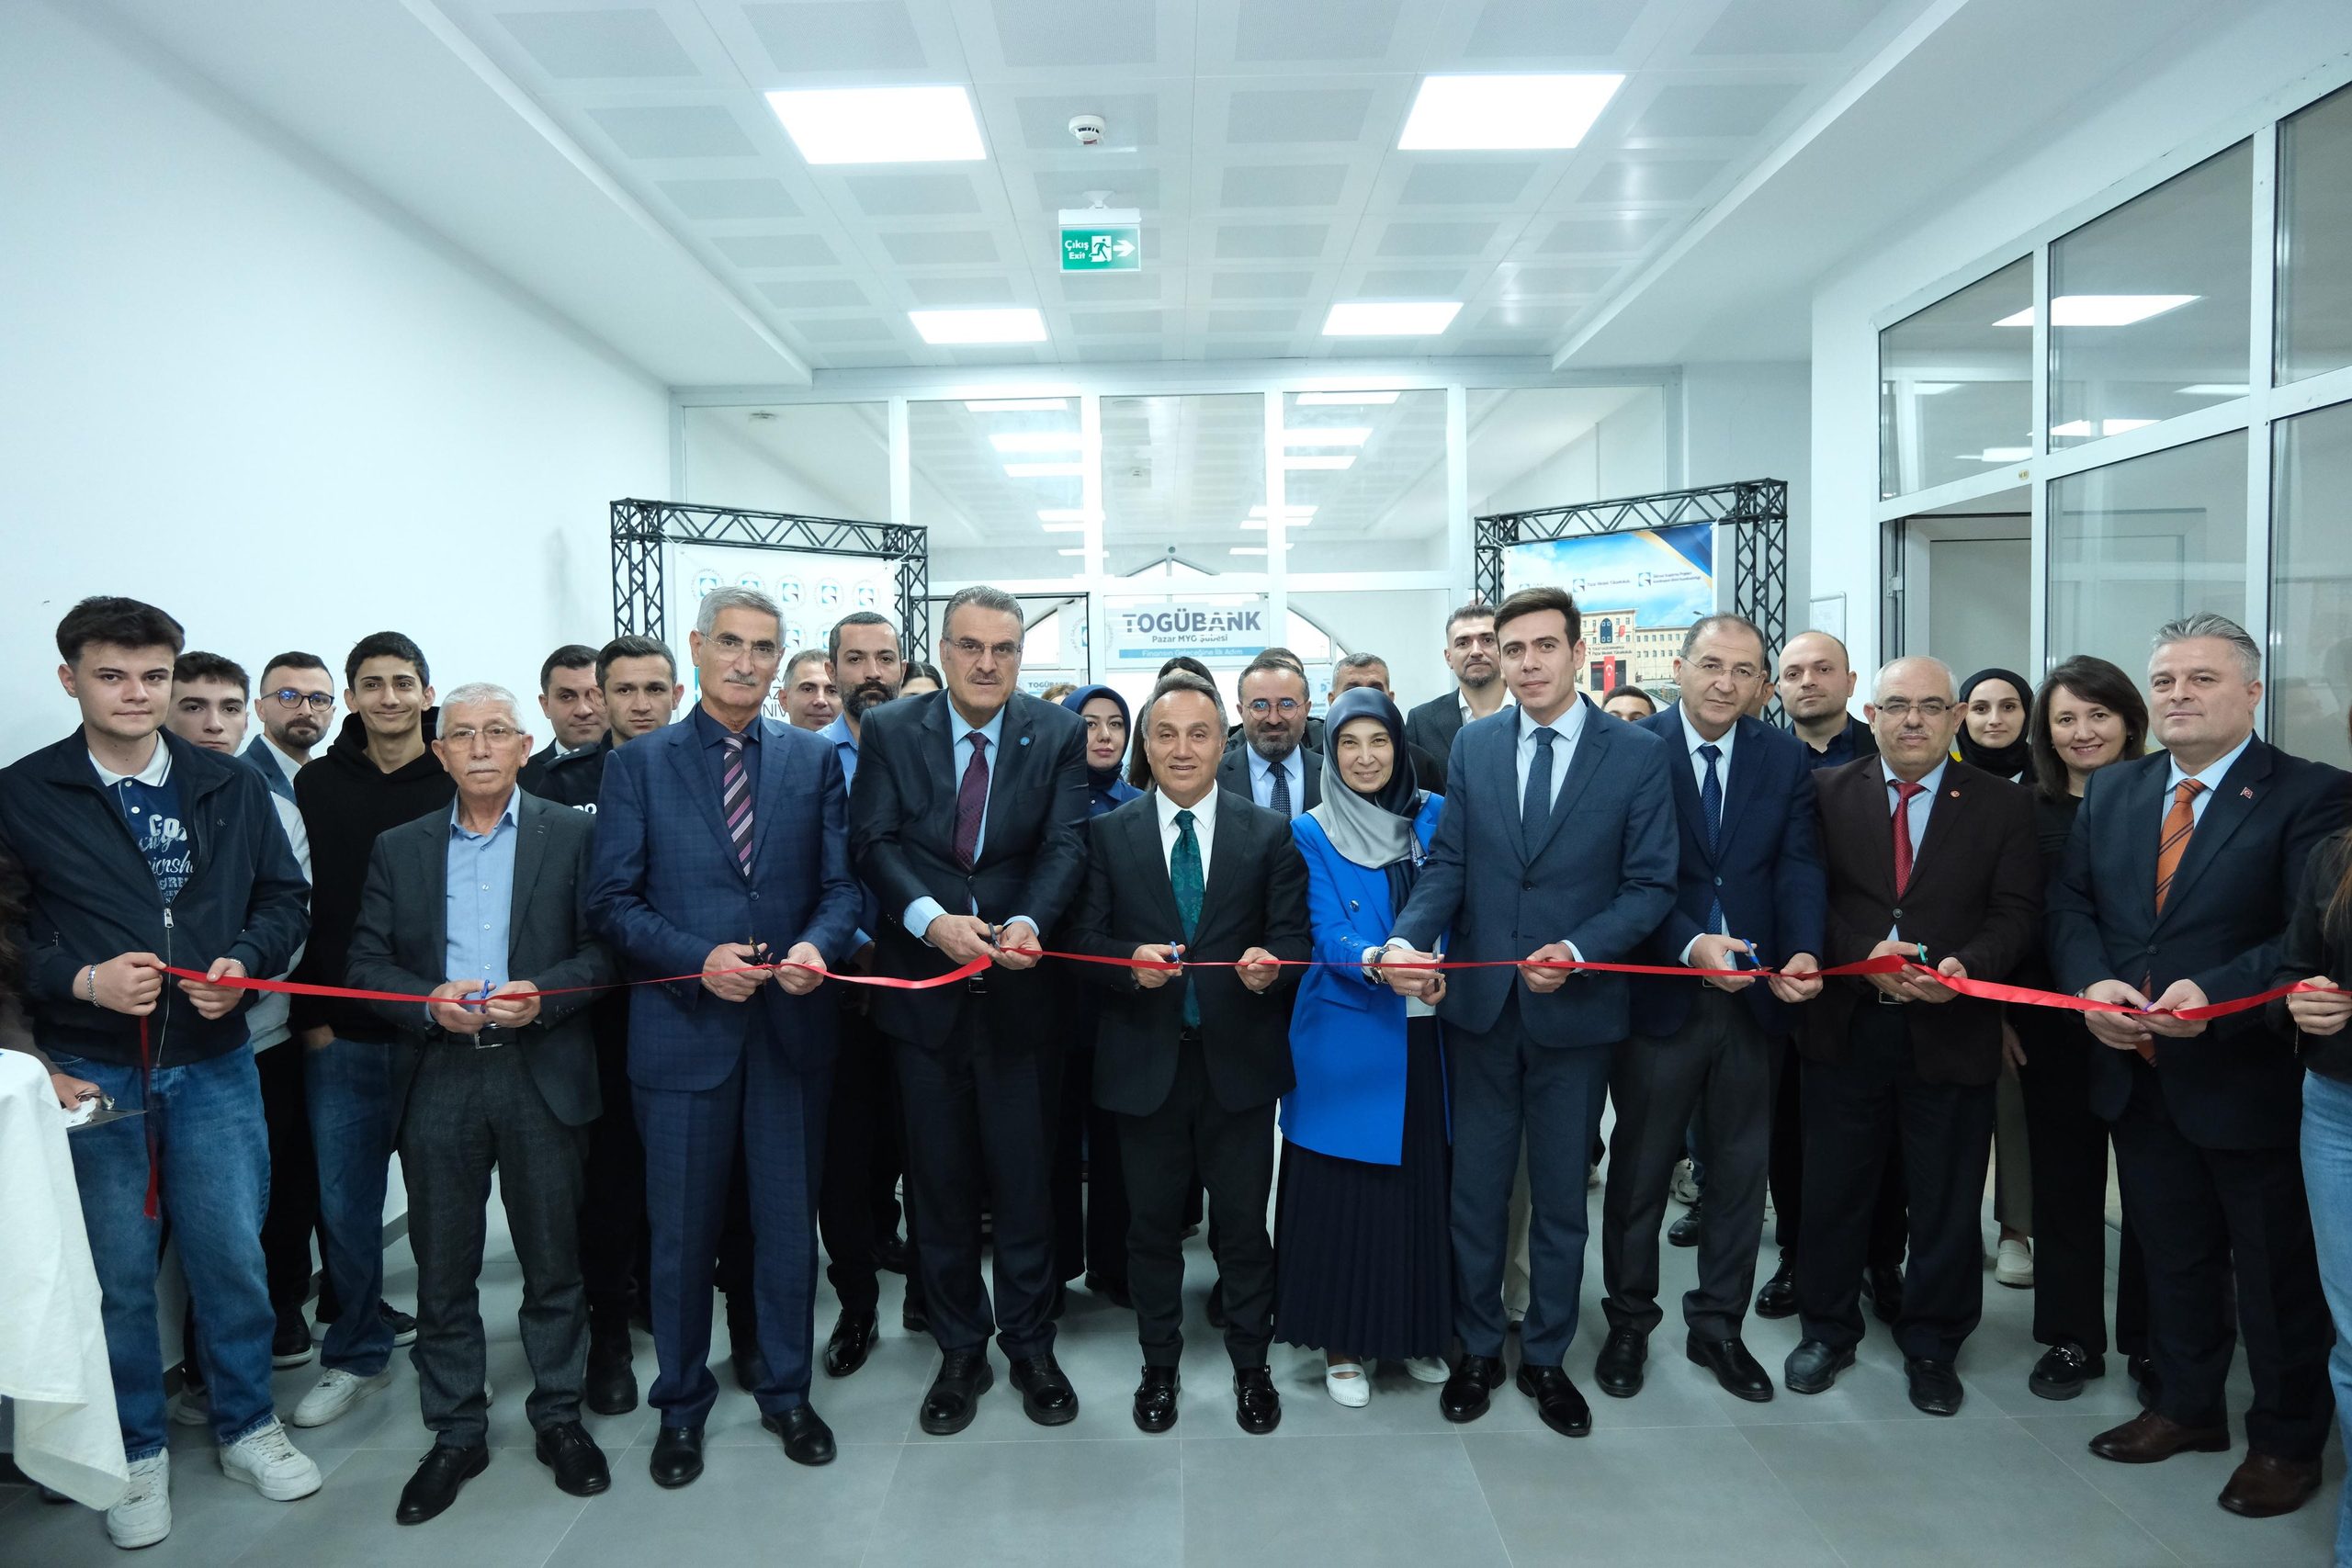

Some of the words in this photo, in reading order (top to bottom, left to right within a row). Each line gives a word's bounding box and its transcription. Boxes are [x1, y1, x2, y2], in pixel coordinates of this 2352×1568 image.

[1065, 240, 1089, 251] Çıkış
[1069, 252, 1086, 260] Exit
[1122, 608, 1261, 634] TOGÜBANK
[1152, 635, 1175, 643] Pazar
